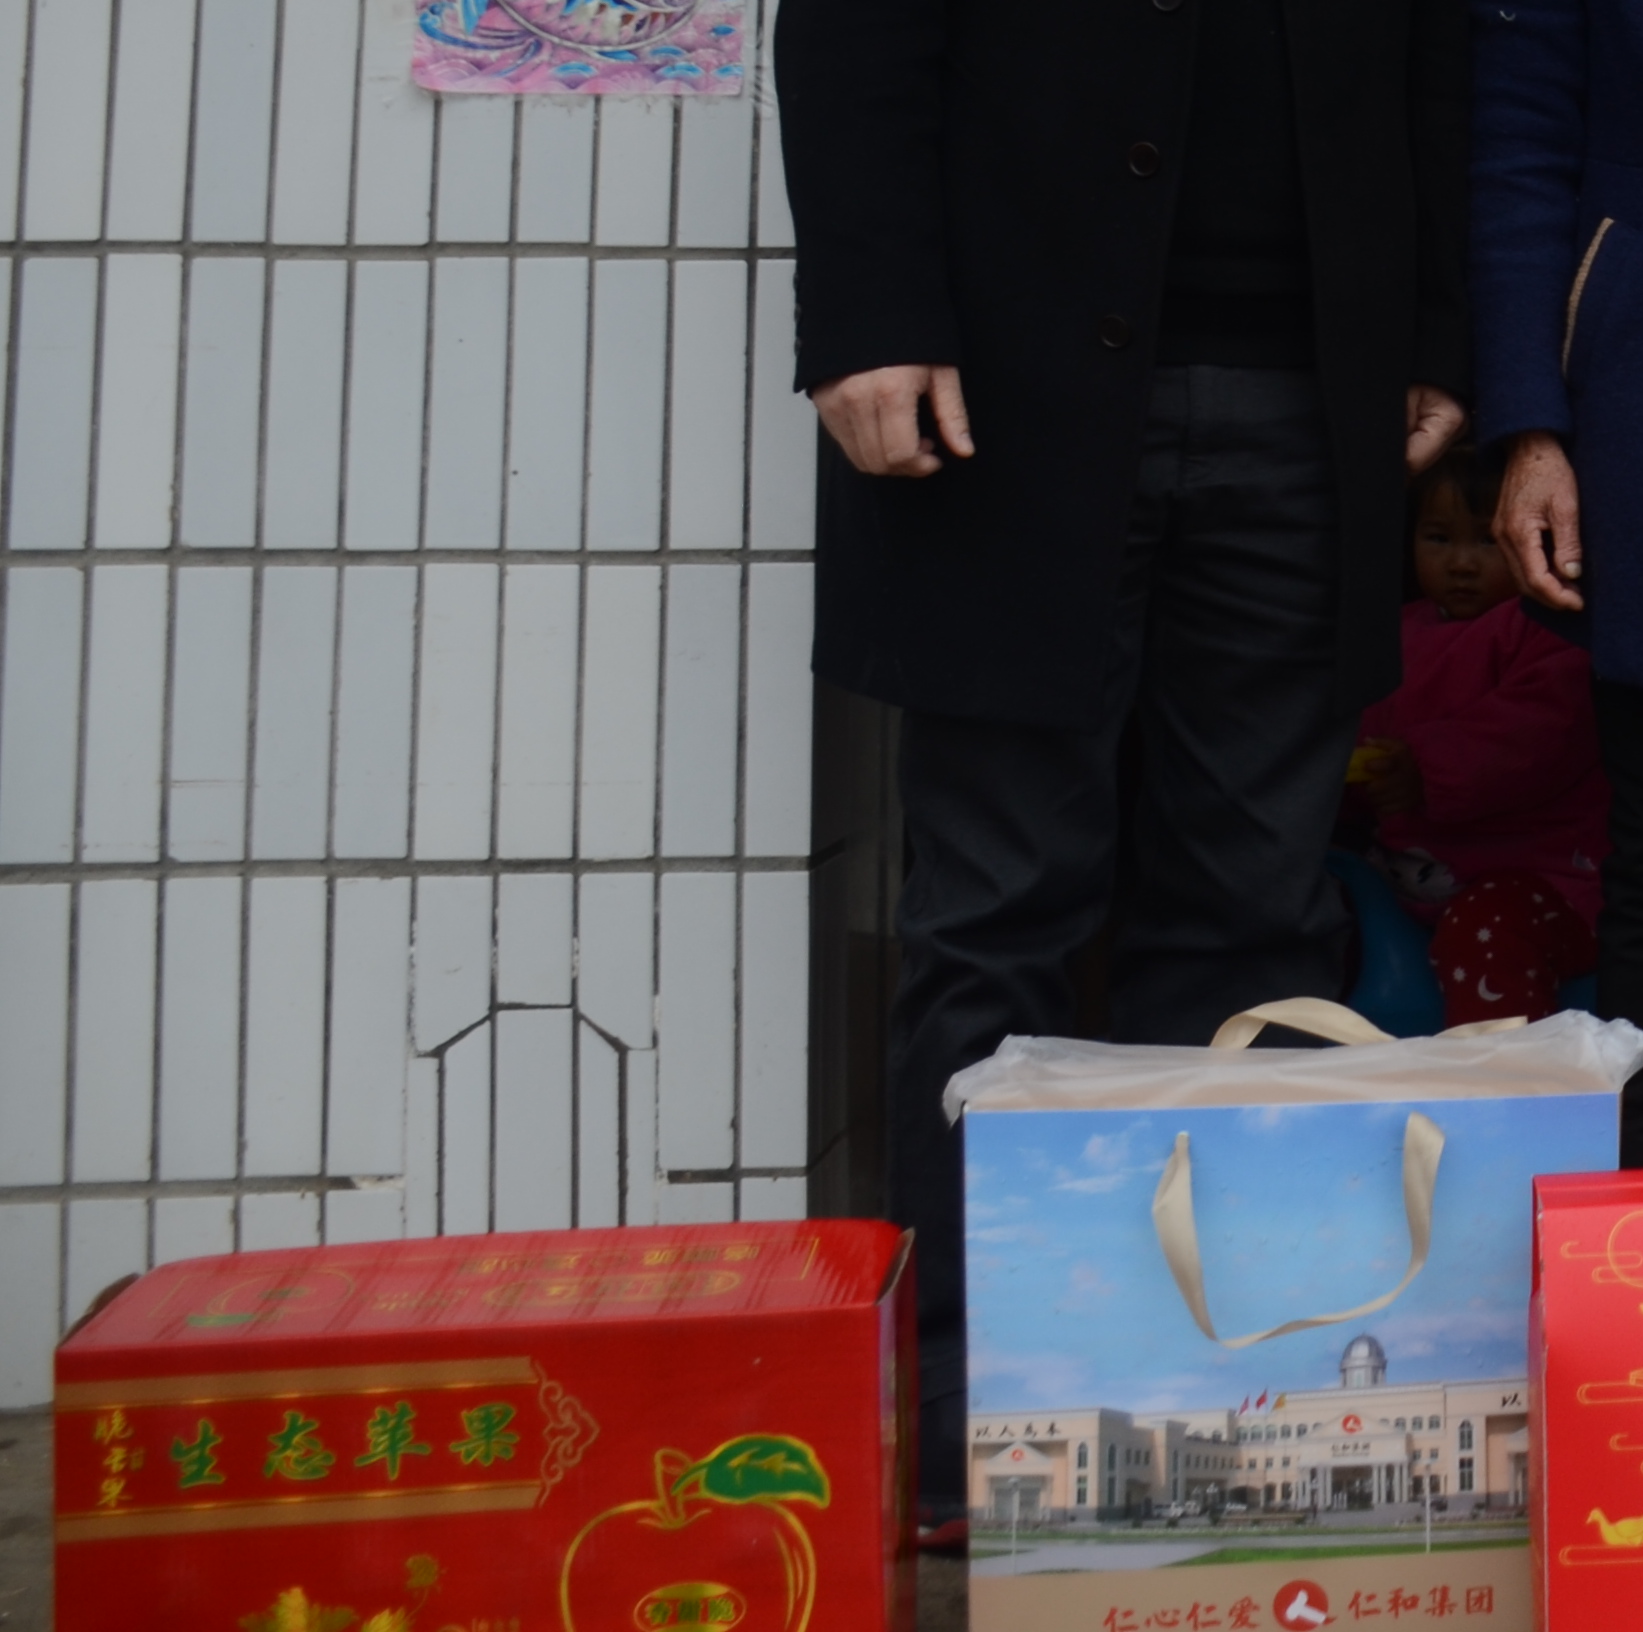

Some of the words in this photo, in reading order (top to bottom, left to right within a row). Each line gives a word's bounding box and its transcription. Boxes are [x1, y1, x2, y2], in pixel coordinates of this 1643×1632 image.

[168, 1399, 522, 1490] 生态苹果
[1103, 1595, 1261, 1632] 仁心仁爱
[1347, 1584, 1495, 1618] 仁和集团
